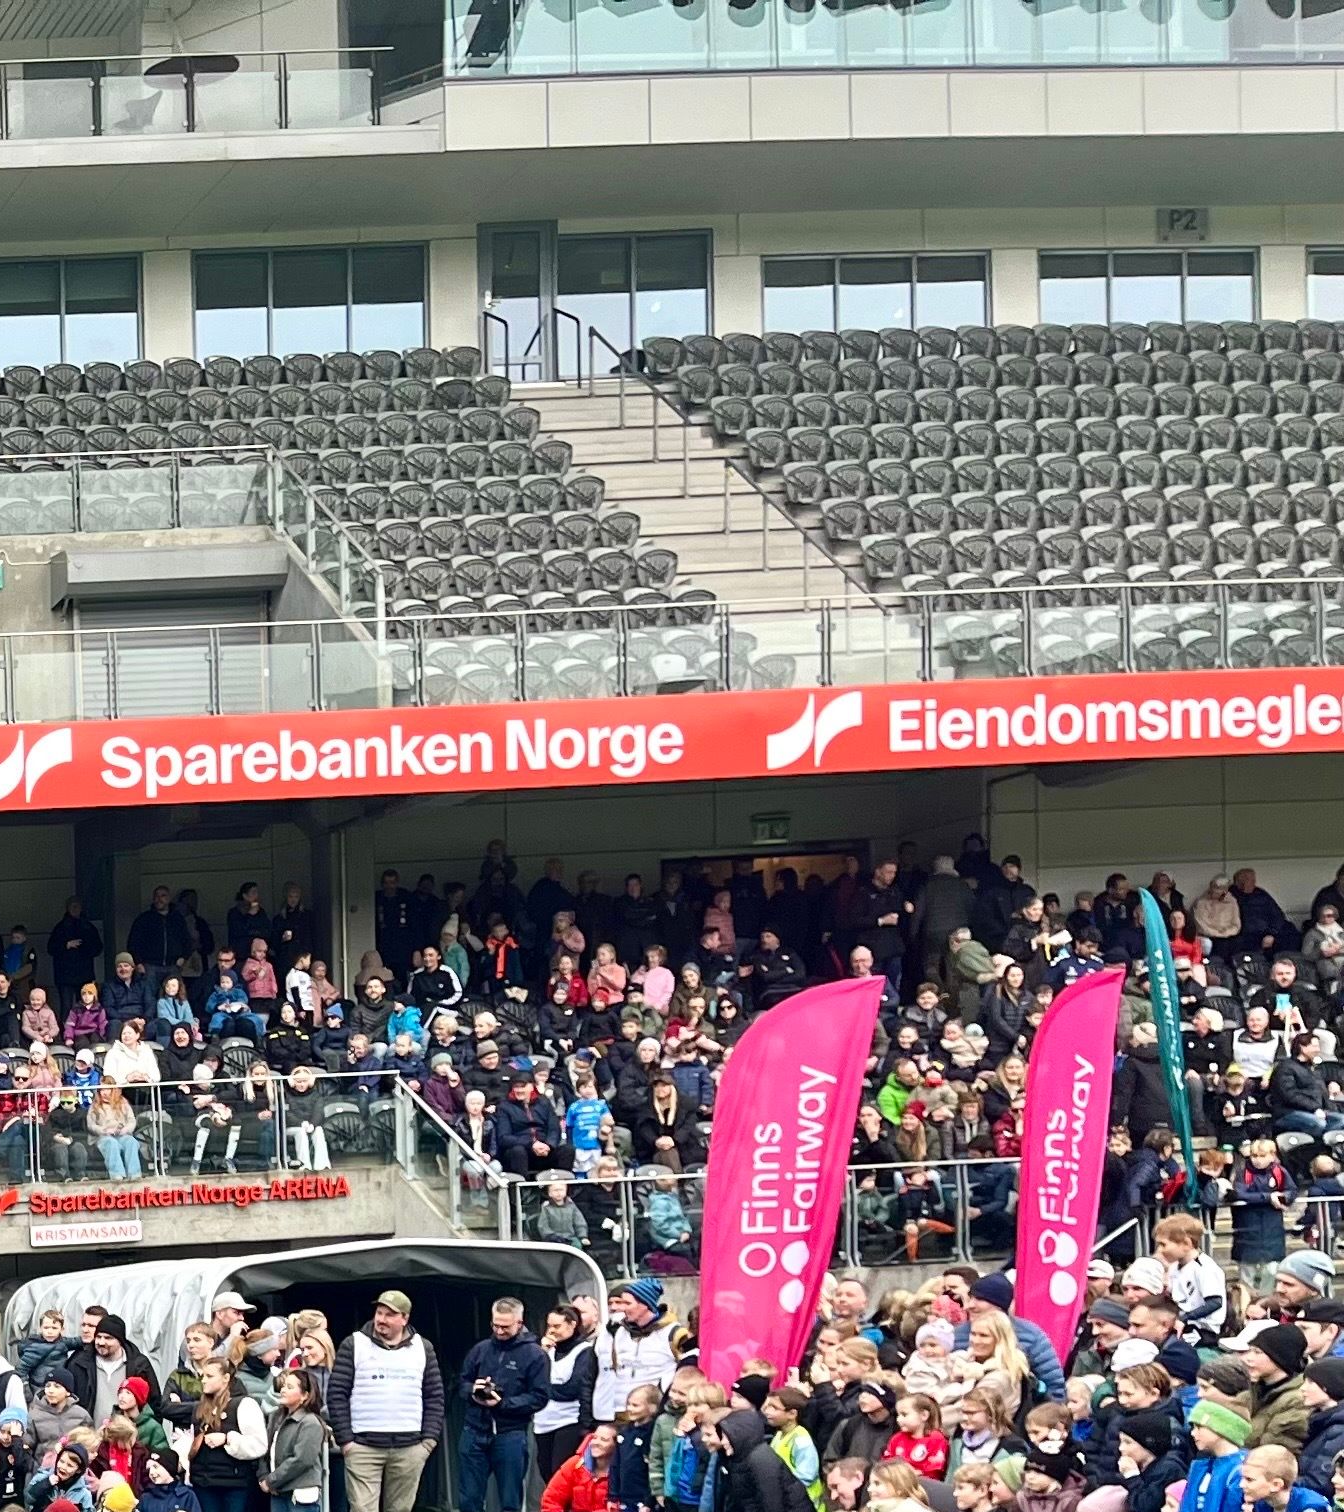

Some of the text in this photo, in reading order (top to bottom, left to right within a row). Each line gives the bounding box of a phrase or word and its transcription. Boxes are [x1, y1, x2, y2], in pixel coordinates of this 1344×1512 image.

[100, 718, 684, 798] Sparebanken Norge
[889, 684, 1344, 752] Eiendomsmegle
[740, 1121, 783, 1235] Finns
[781, 1064, 838, 1234] Fairway
[1038, 1109, 1068, 1222] Finns
[29, 1175, 353, 1217] Sparebanken Norge ARENA
[35, 1224, 139, 1241] KRISTIANSAND
